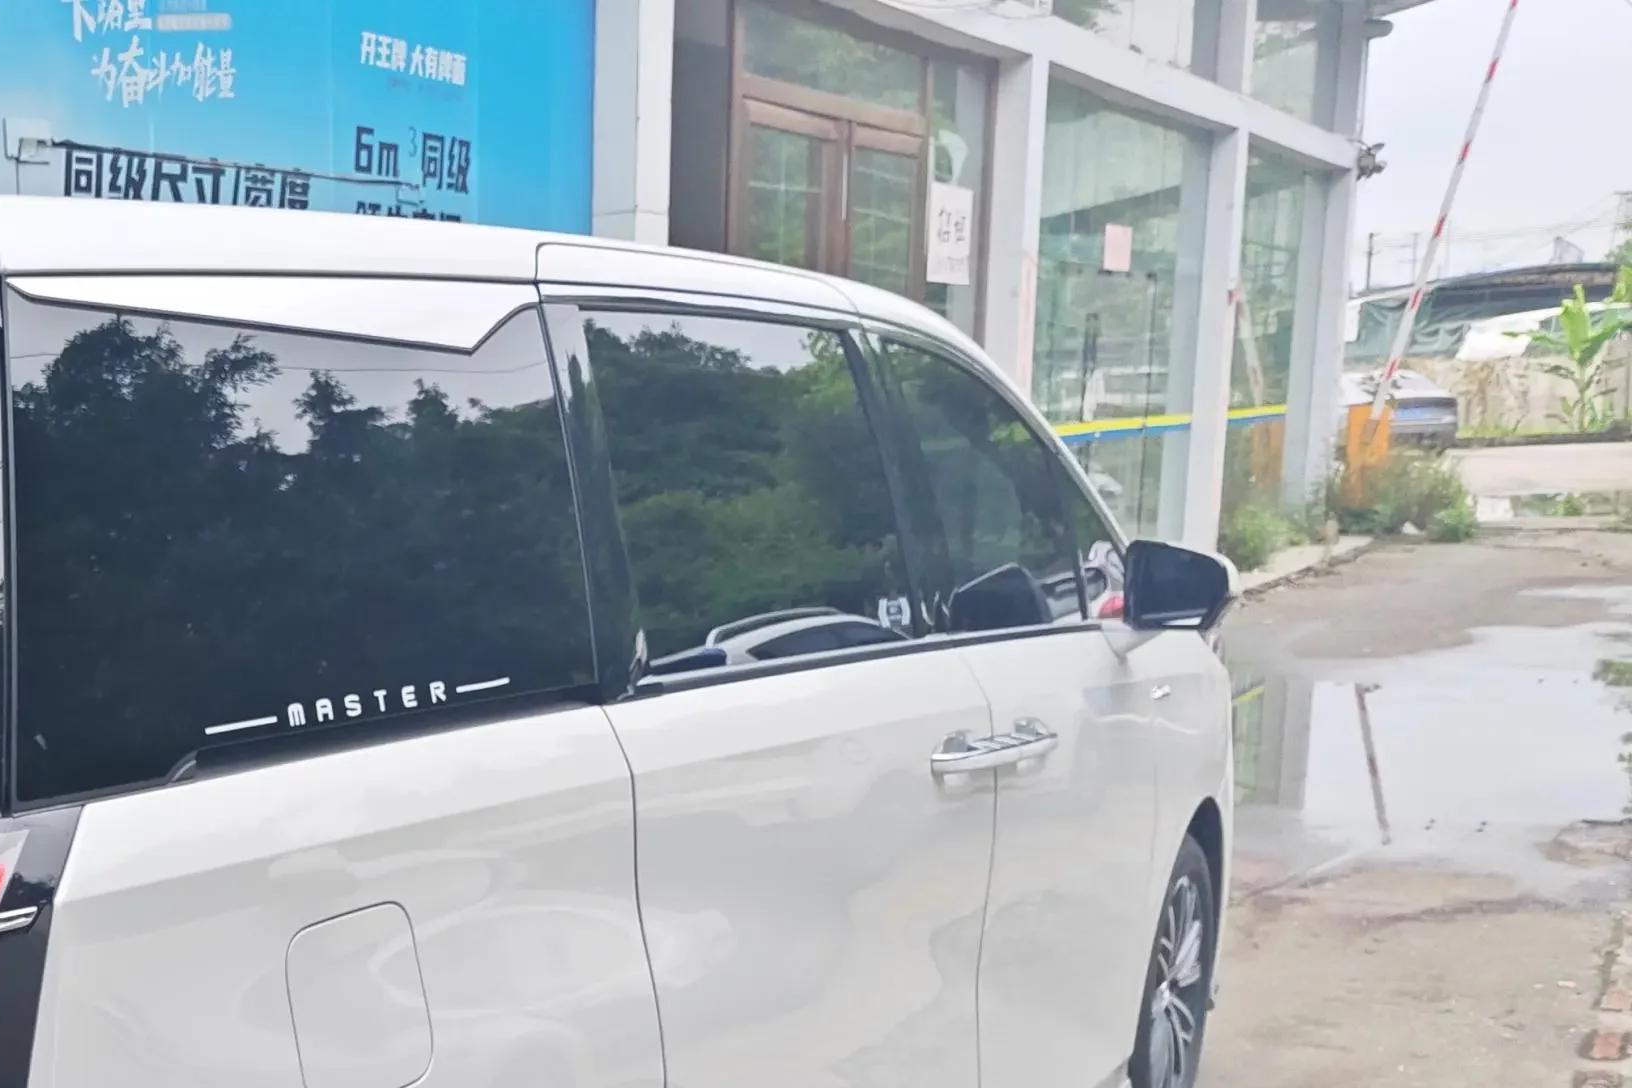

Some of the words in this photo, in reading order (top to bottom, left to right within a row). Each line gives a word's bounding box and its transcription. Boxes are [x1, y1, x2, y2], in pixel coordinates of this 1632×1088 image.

[90, 35, 237, 108] 为奋斗加能量
[360, 31, 408, 73] 开王牌
[409, 44, 468, 86] 大有牌面
[287, 681, 447, 727] MASTER
